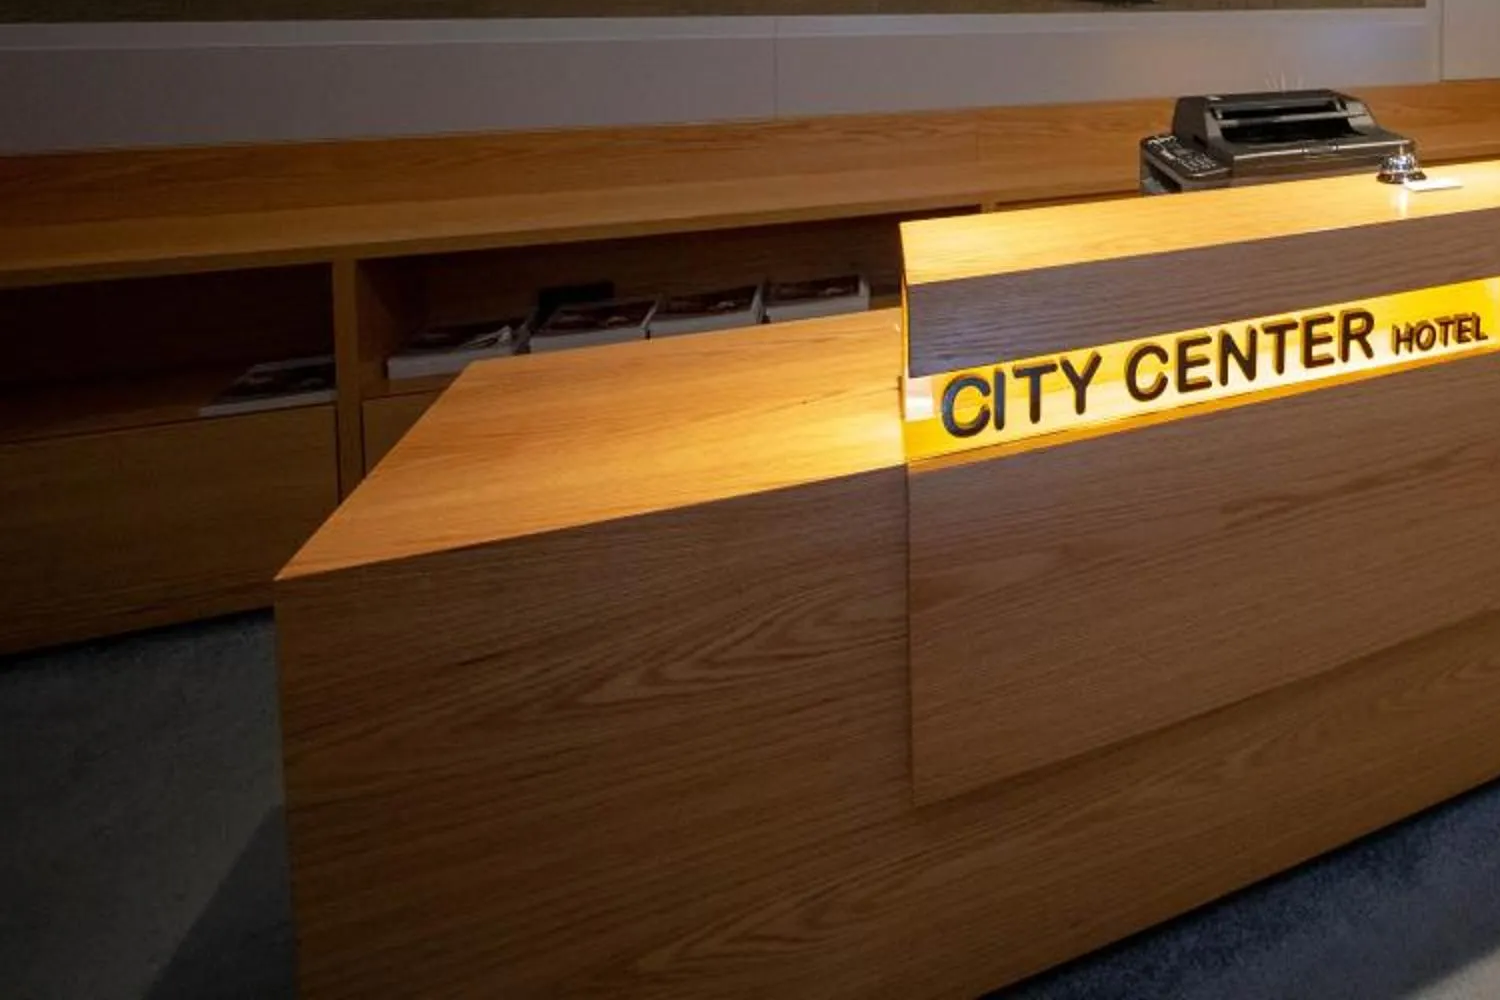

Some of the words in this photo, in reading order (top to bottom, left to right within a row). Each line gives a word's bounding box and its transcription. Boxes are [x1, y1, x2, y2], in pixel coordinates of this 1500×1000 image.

[941, 351, 1102, 438] CITY
[1124, 307, 1375, 402] CENTER
[1392, 311, 1489, 356] HOTEL
